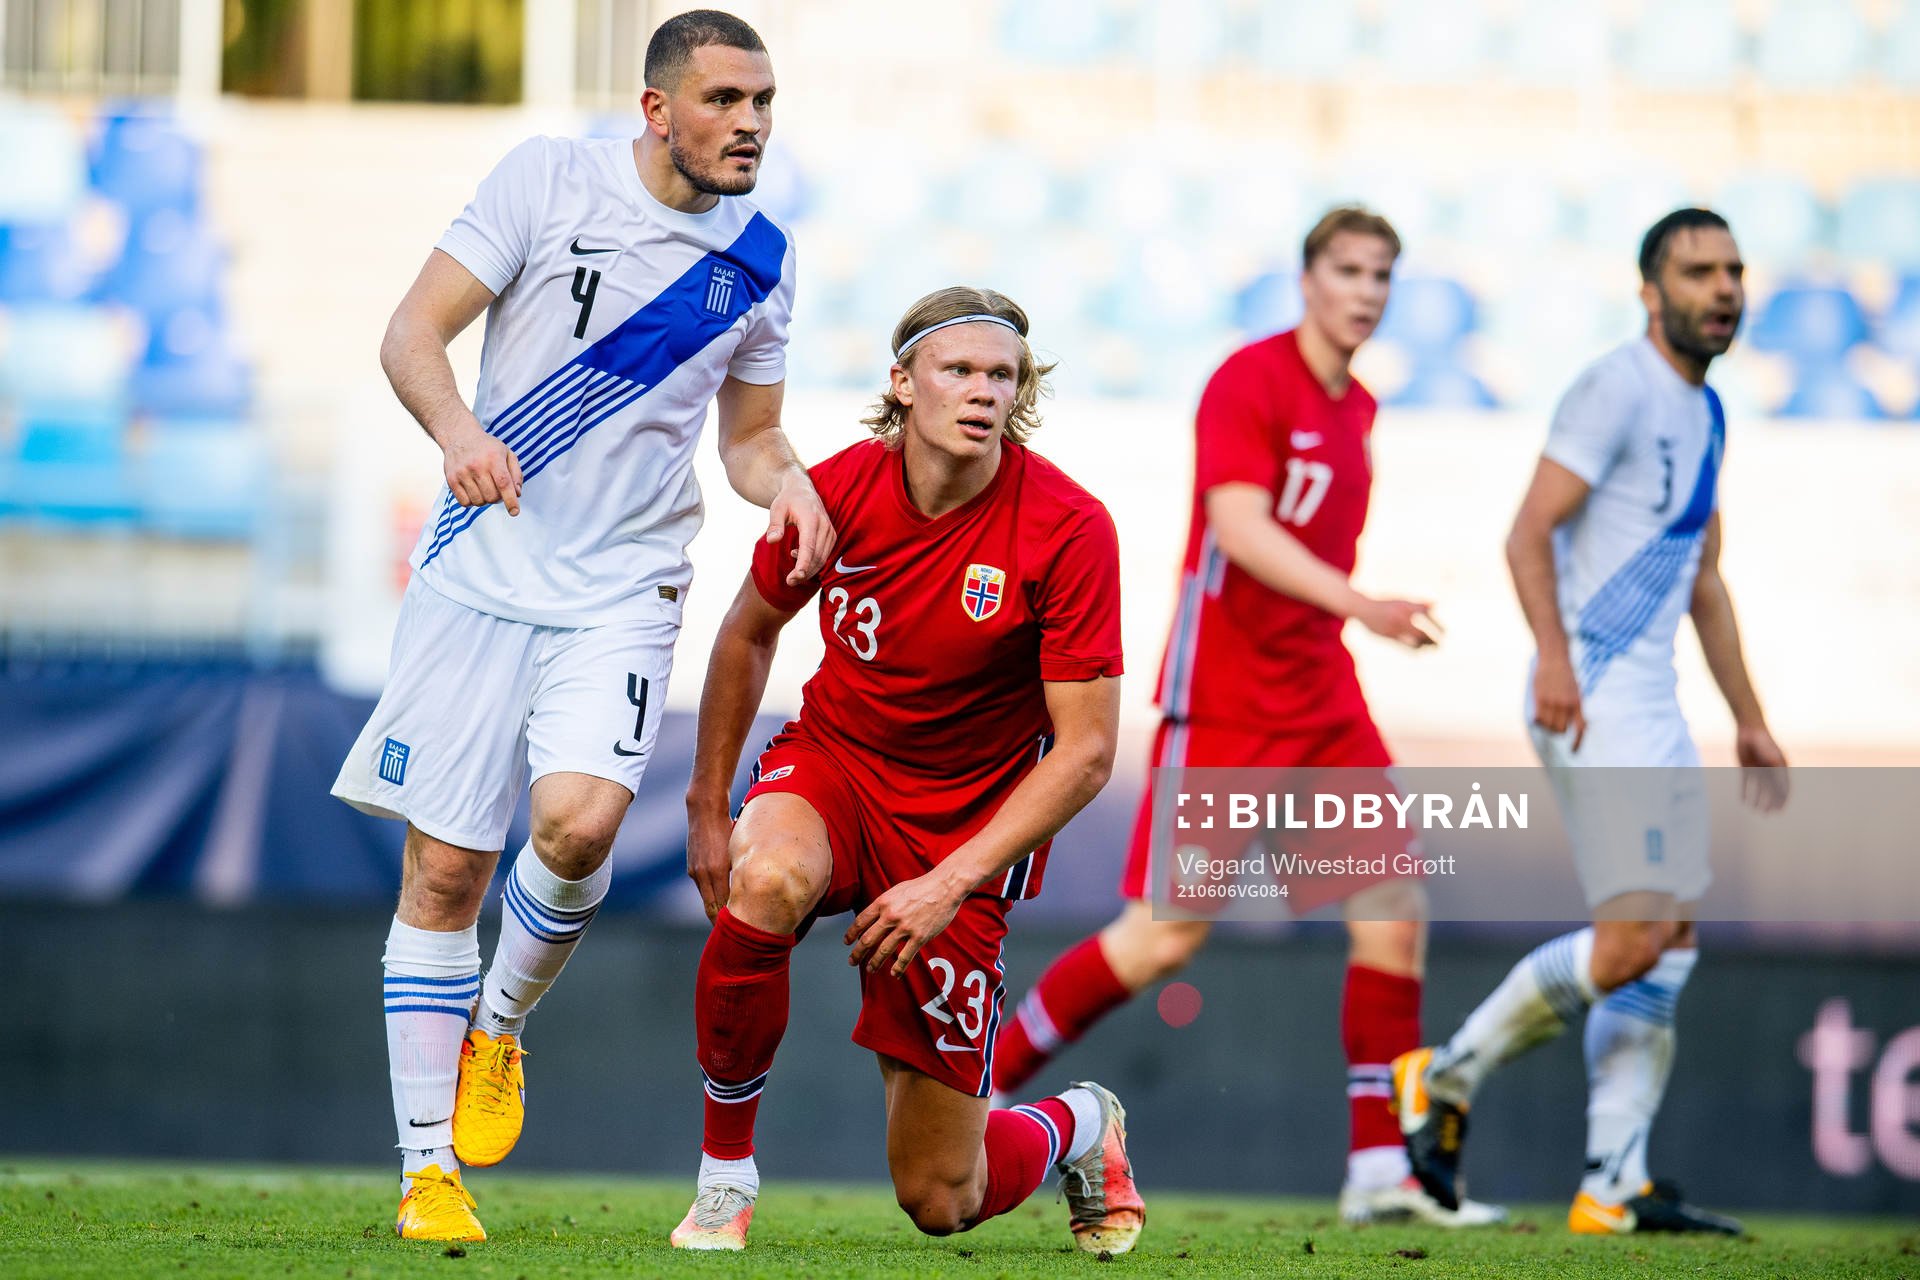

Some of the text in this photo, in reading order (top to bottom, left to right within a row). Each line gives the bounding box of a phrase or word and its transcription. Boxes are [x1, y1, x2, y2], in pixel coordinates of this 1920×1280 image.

[570, 265, 602, 340] 4
[1276, 458, 1334, 527] 17
[828, 586, 882, 661] 23
[626, 671, 649, 743] 4
[920, 957, 987, 1040] 23
